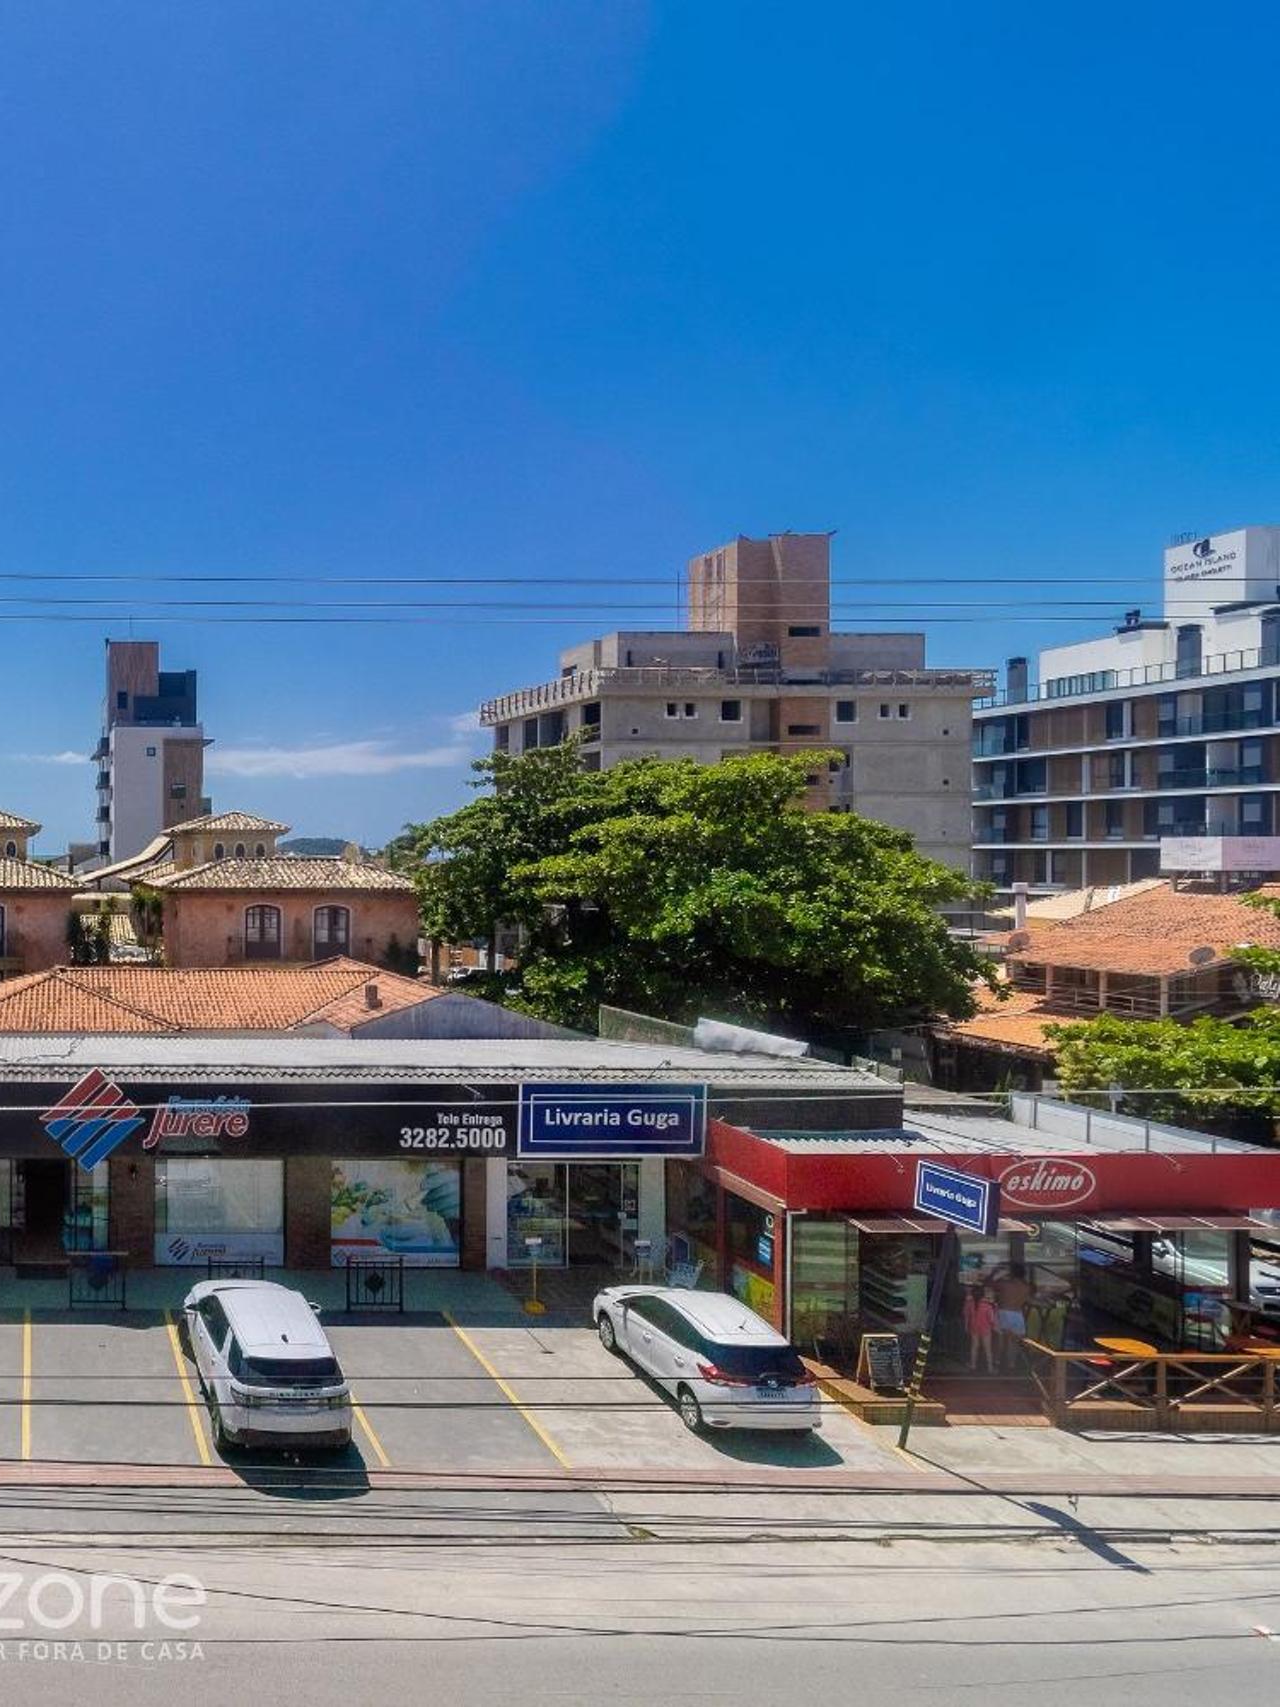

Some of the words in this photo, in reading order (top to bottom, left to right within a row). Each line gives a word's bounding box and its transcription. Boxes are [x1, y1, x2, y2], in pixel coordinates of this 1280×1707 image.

[1170, 560, 1202, 574] OCEAN
[1205, 552, 1237, 566] ISLAND
[462, 1112, 503, 1128] Entrega
[545, 1108, 621, 1126] Livraria
[627, 1109, 680, 1130] Guga
[400, 1127, 506, 1149] 3282.5000
